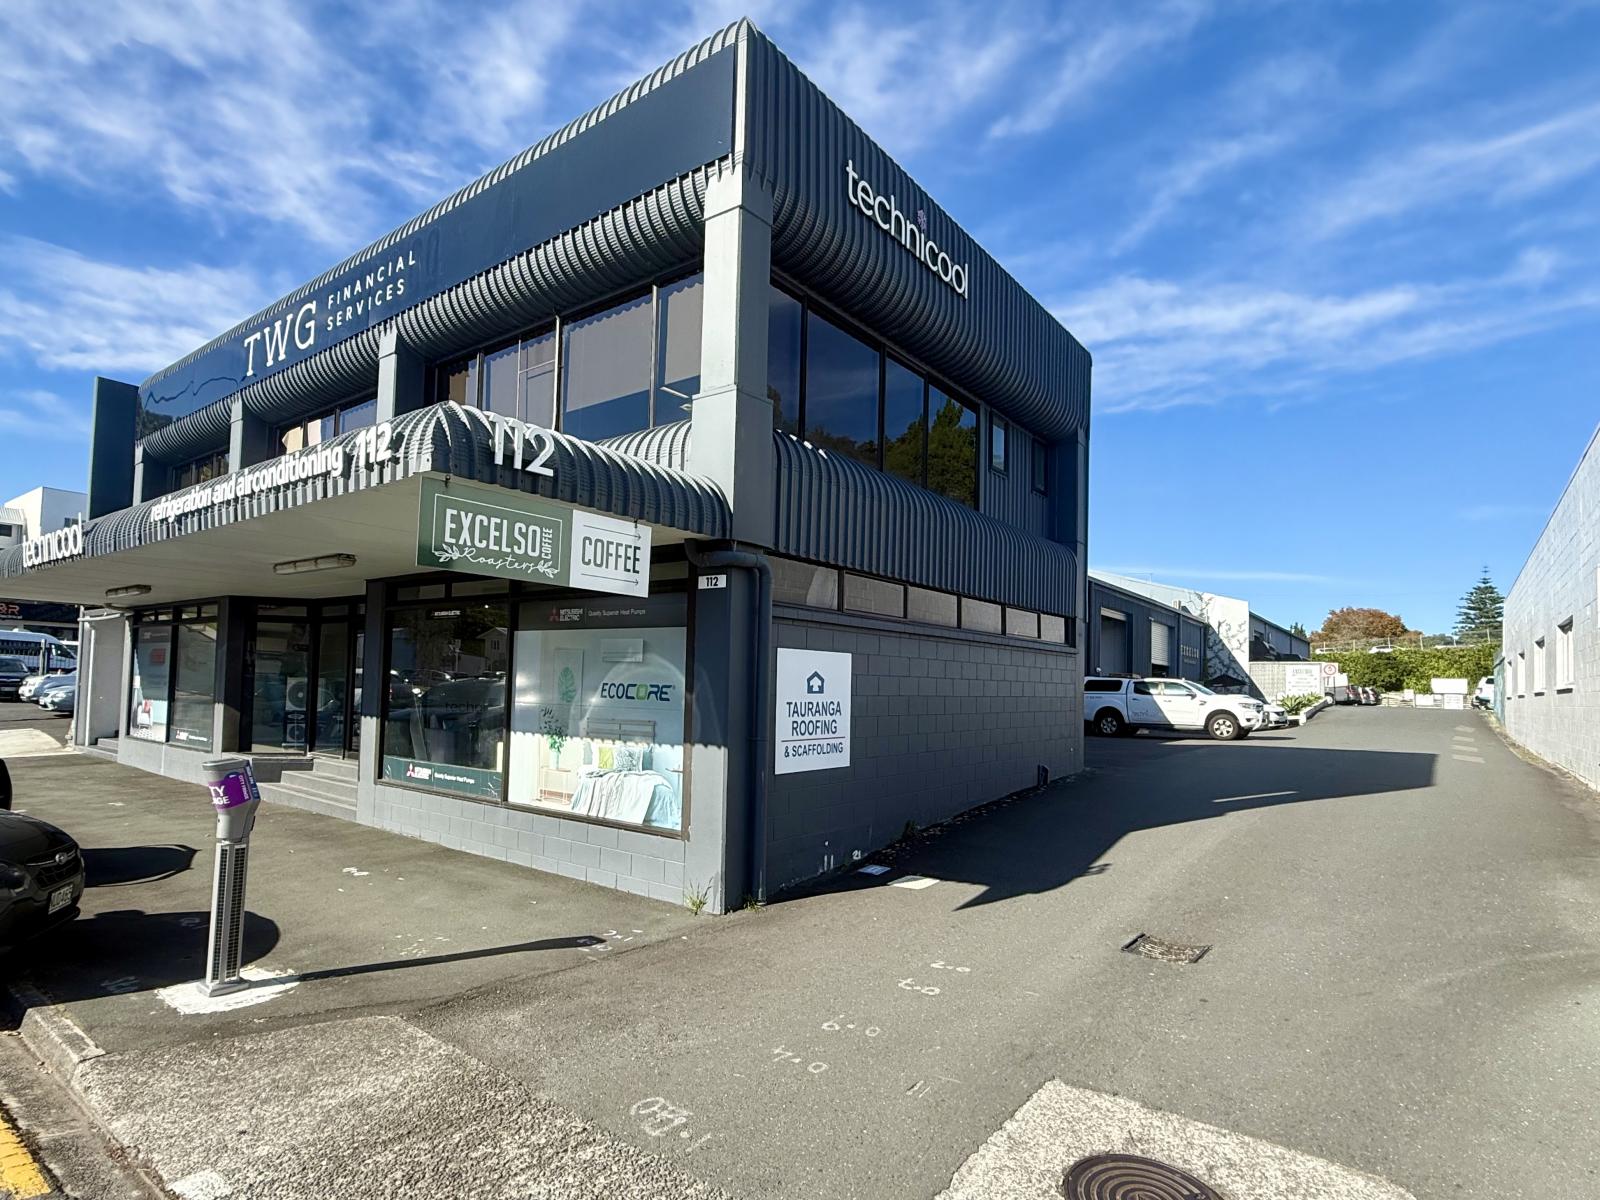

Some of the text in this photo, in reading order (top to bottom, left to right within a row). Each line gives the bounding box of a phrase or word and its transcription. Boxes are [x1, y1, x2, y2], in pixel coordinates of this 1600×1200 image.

[845, 159, 968, 300] technicool
[326, 278, 405, 331] SERVICES
[327, 250, 416, 310] FINANCIAL
[243, 300, 316, 377] TWG
[489, 413, 554, 477] 112
[150, 422, 393, 523] refrigeration and airconditioning 112
[22, 511, 82, 568] technicool
[444, 508, 541, 557] EXCELSO
[541, 527, 553, 560] COFFEE
[582, 536, 641, 574] COFFEE
[458, 546, 535, 574] Roasters
[705, 576, 719, 588] 112
[786, 701, 842, 718] TAURANGA
[791, 719, 838, 737] ROOFING
[784, 741, 844, 758] & SCAFFOLDING
